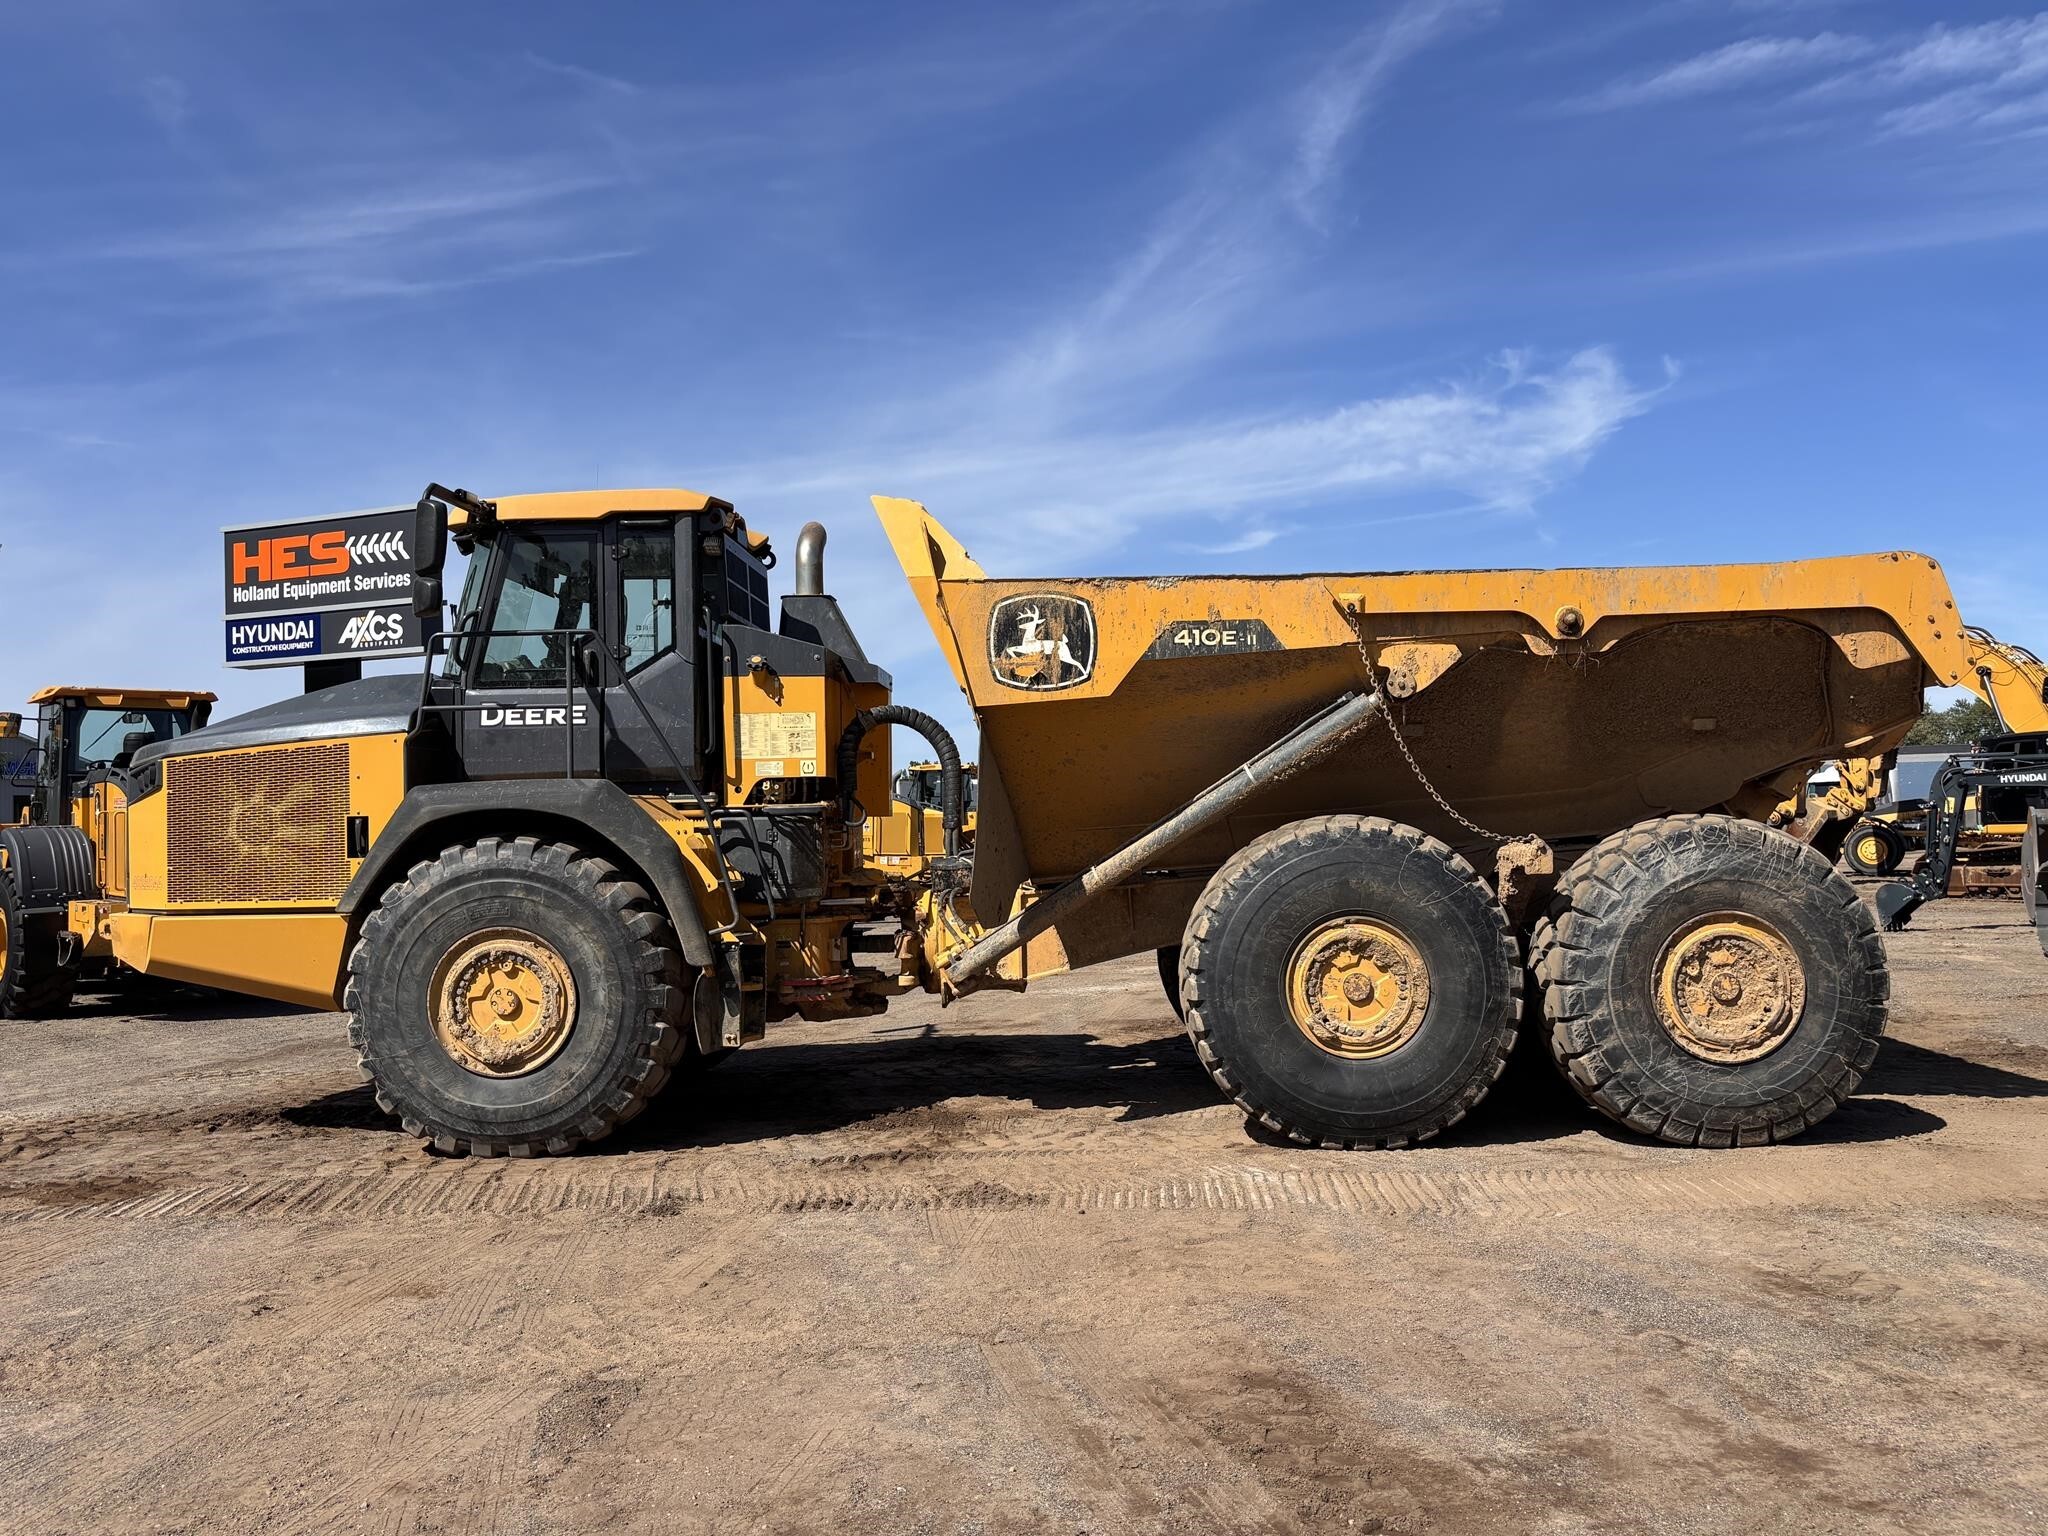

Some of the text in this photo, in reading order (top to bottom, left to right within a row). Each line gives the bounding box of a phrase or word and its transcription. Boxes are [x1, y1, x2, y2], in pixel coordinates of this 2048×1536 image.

[233, 530, 350, 585] HES
[233, 572, 411, 603] Holland Equipment Services
[232, 619, 314, 645] HYUNDAI
[360, 638, 404, 648] EQUIPMENT
[232, 641, 314, 655] CONSTRUCTION EQUIPMENT
[480, 702, 587, 726] DEERE
[2000, 773, 2047, 784] HYUNDAI
